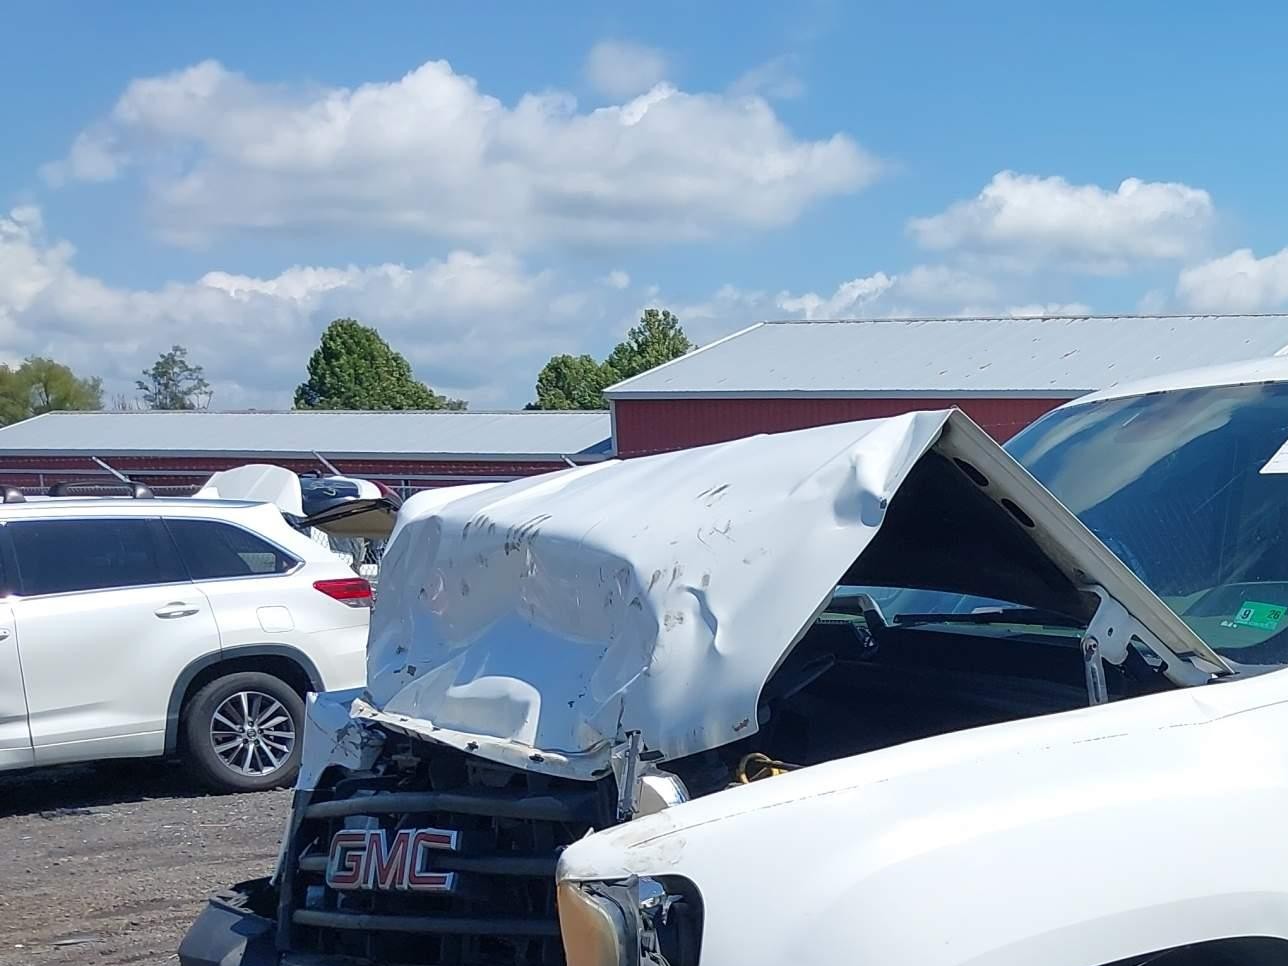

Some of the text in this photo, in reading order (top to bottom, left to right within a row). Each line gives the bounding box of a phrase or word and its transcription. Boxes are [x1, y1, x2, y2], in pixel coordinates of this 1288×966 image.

[1241, 609, 1282, 620] 9 26
[326, 827, 458, 891] GMC
